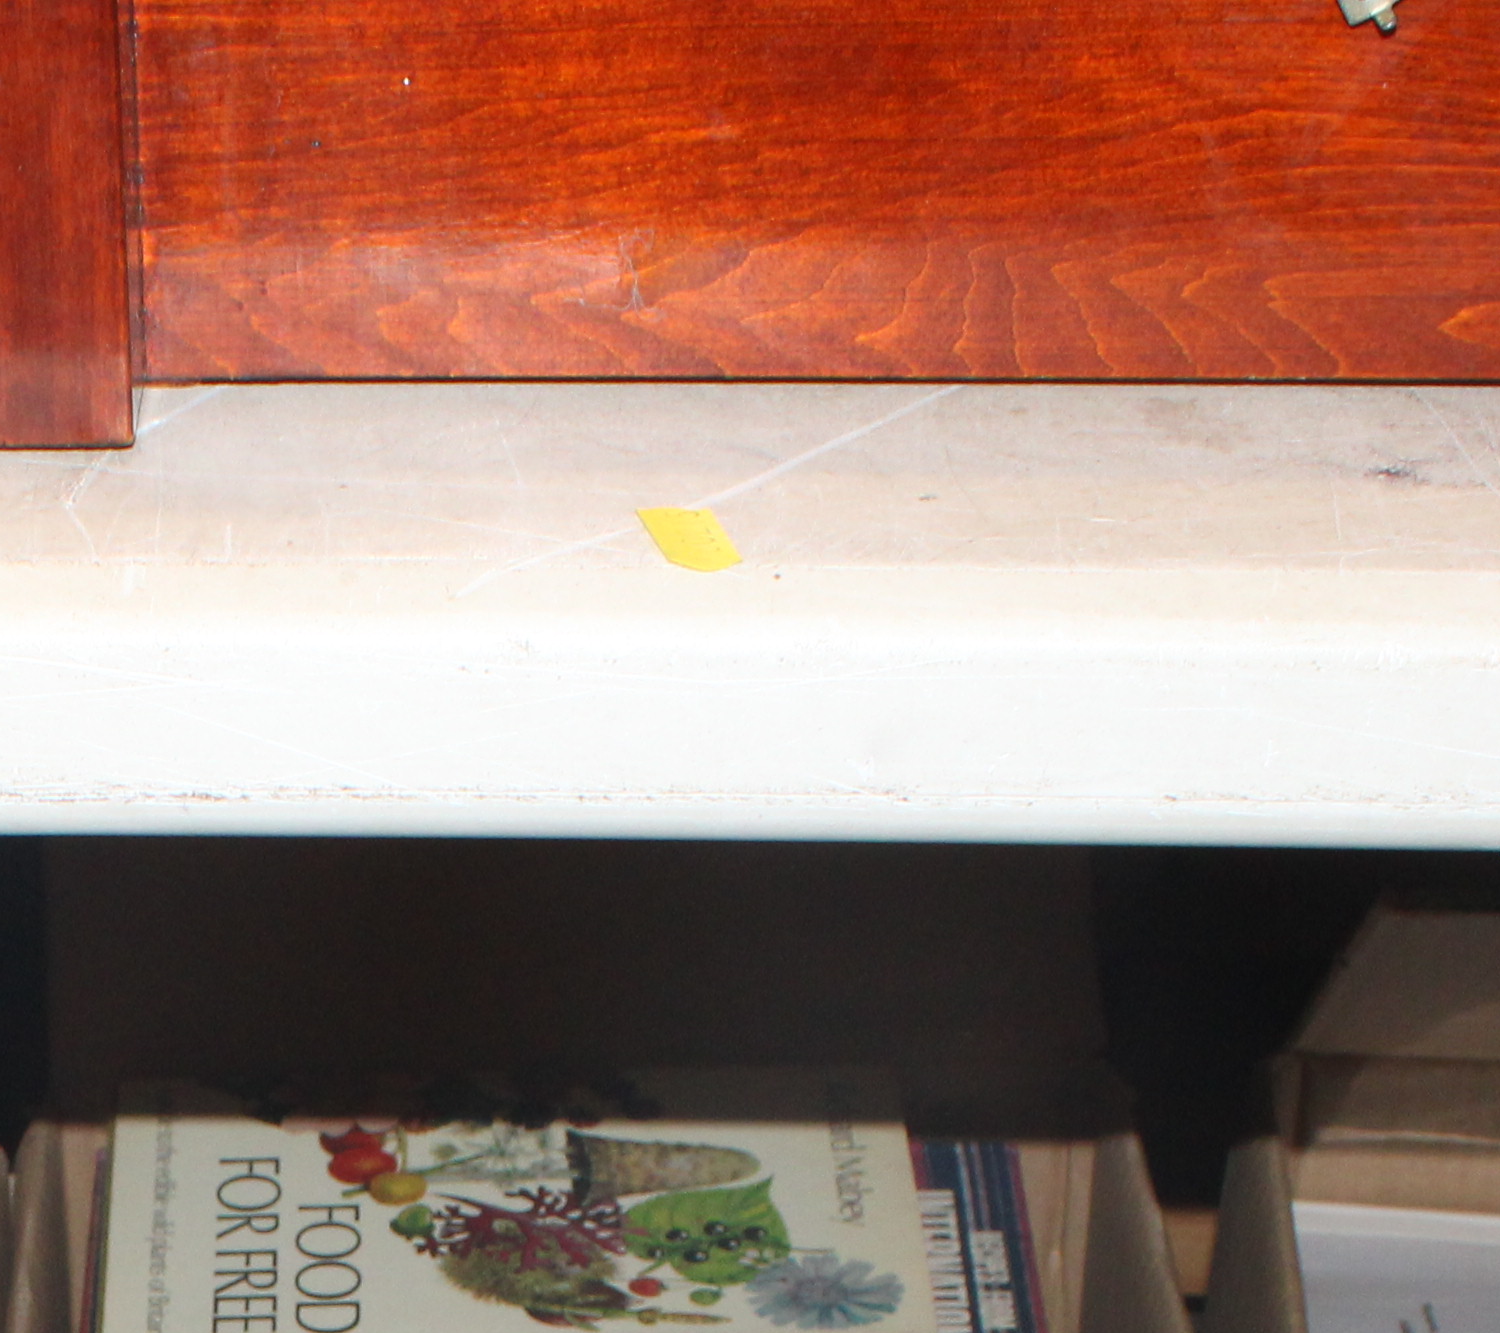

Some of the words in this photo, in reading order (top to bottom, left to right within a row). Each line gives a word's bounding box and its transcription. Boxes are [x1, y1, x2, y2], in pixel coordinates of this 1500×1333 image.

[216, 1156, 281, 1239] FOR
[834, 1156, 878, 1227] Mabey
[295, 1204, 362, 1333] FOOD
